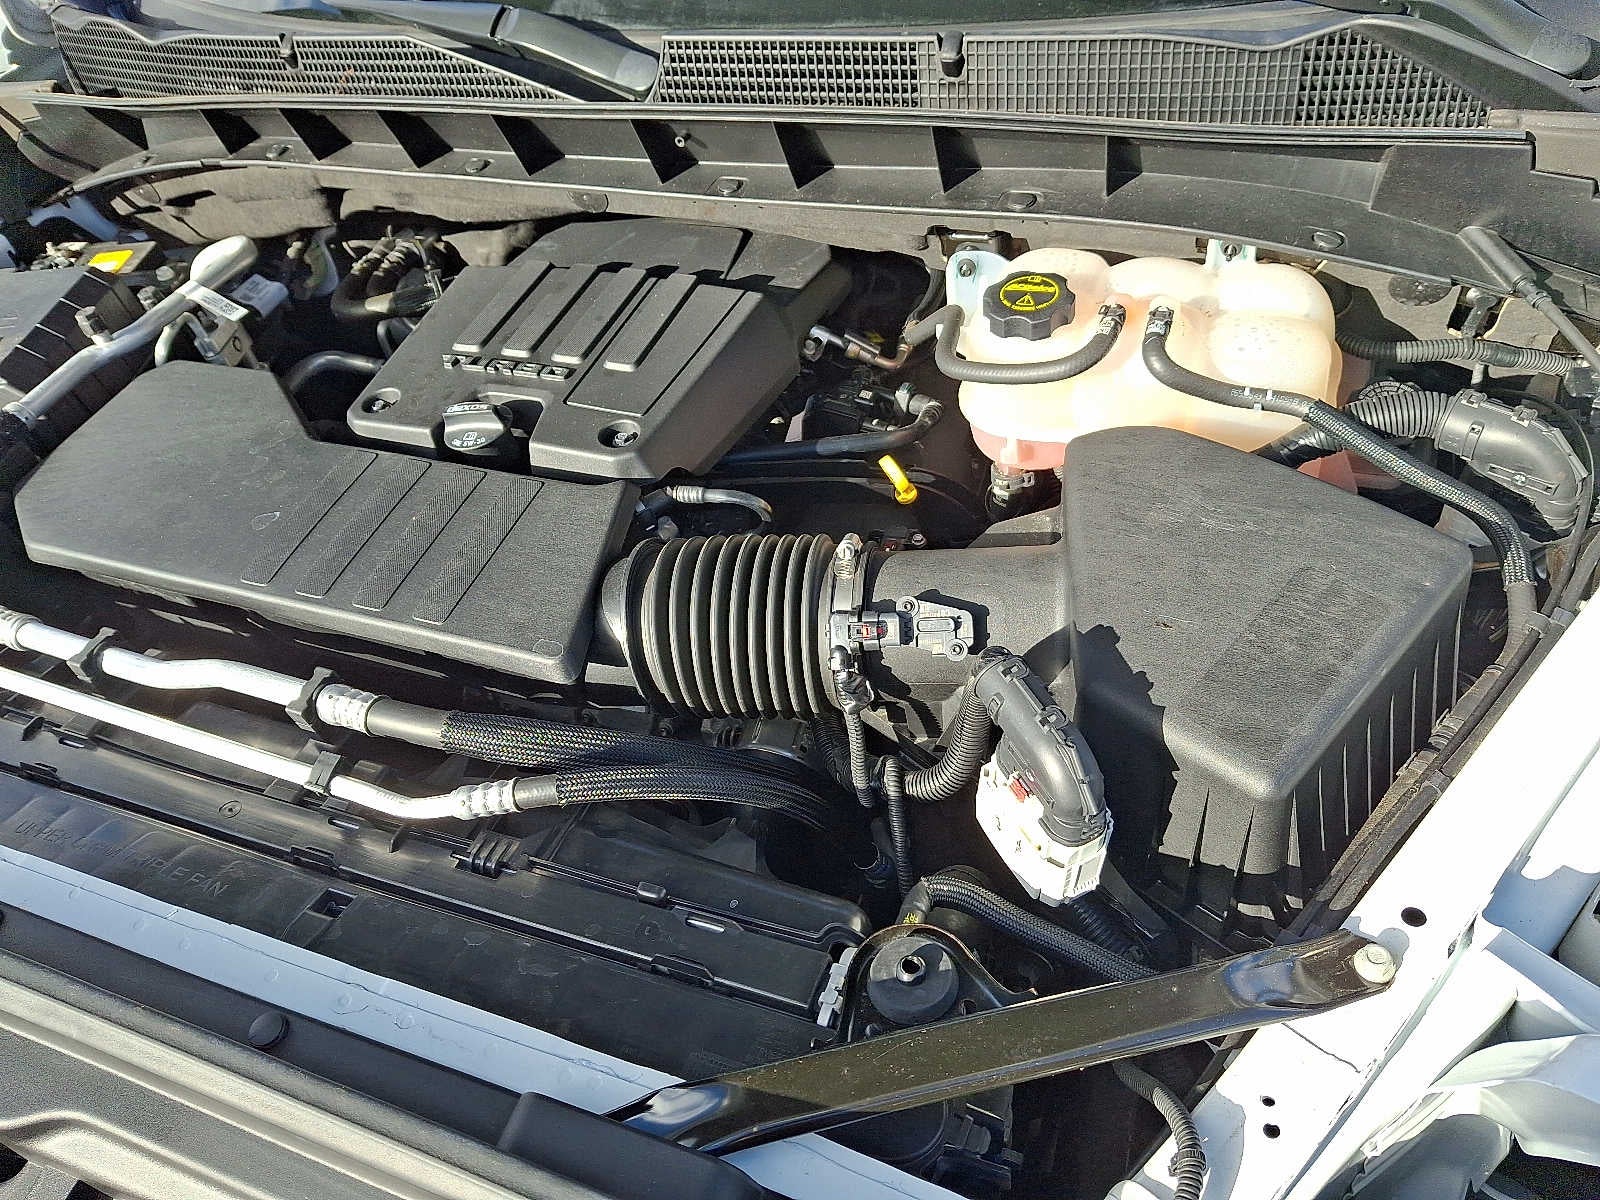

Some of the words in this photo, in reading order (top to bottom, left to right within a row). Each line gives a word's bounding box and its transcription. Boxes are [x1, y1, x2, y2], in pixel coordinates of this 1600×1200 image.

[441, 354, 576, 382] TURBO
[446, 403, 489, 413] dexos
[463, 436, 486, 448] 5W-30
[184, 871, 232, 898] FAN
